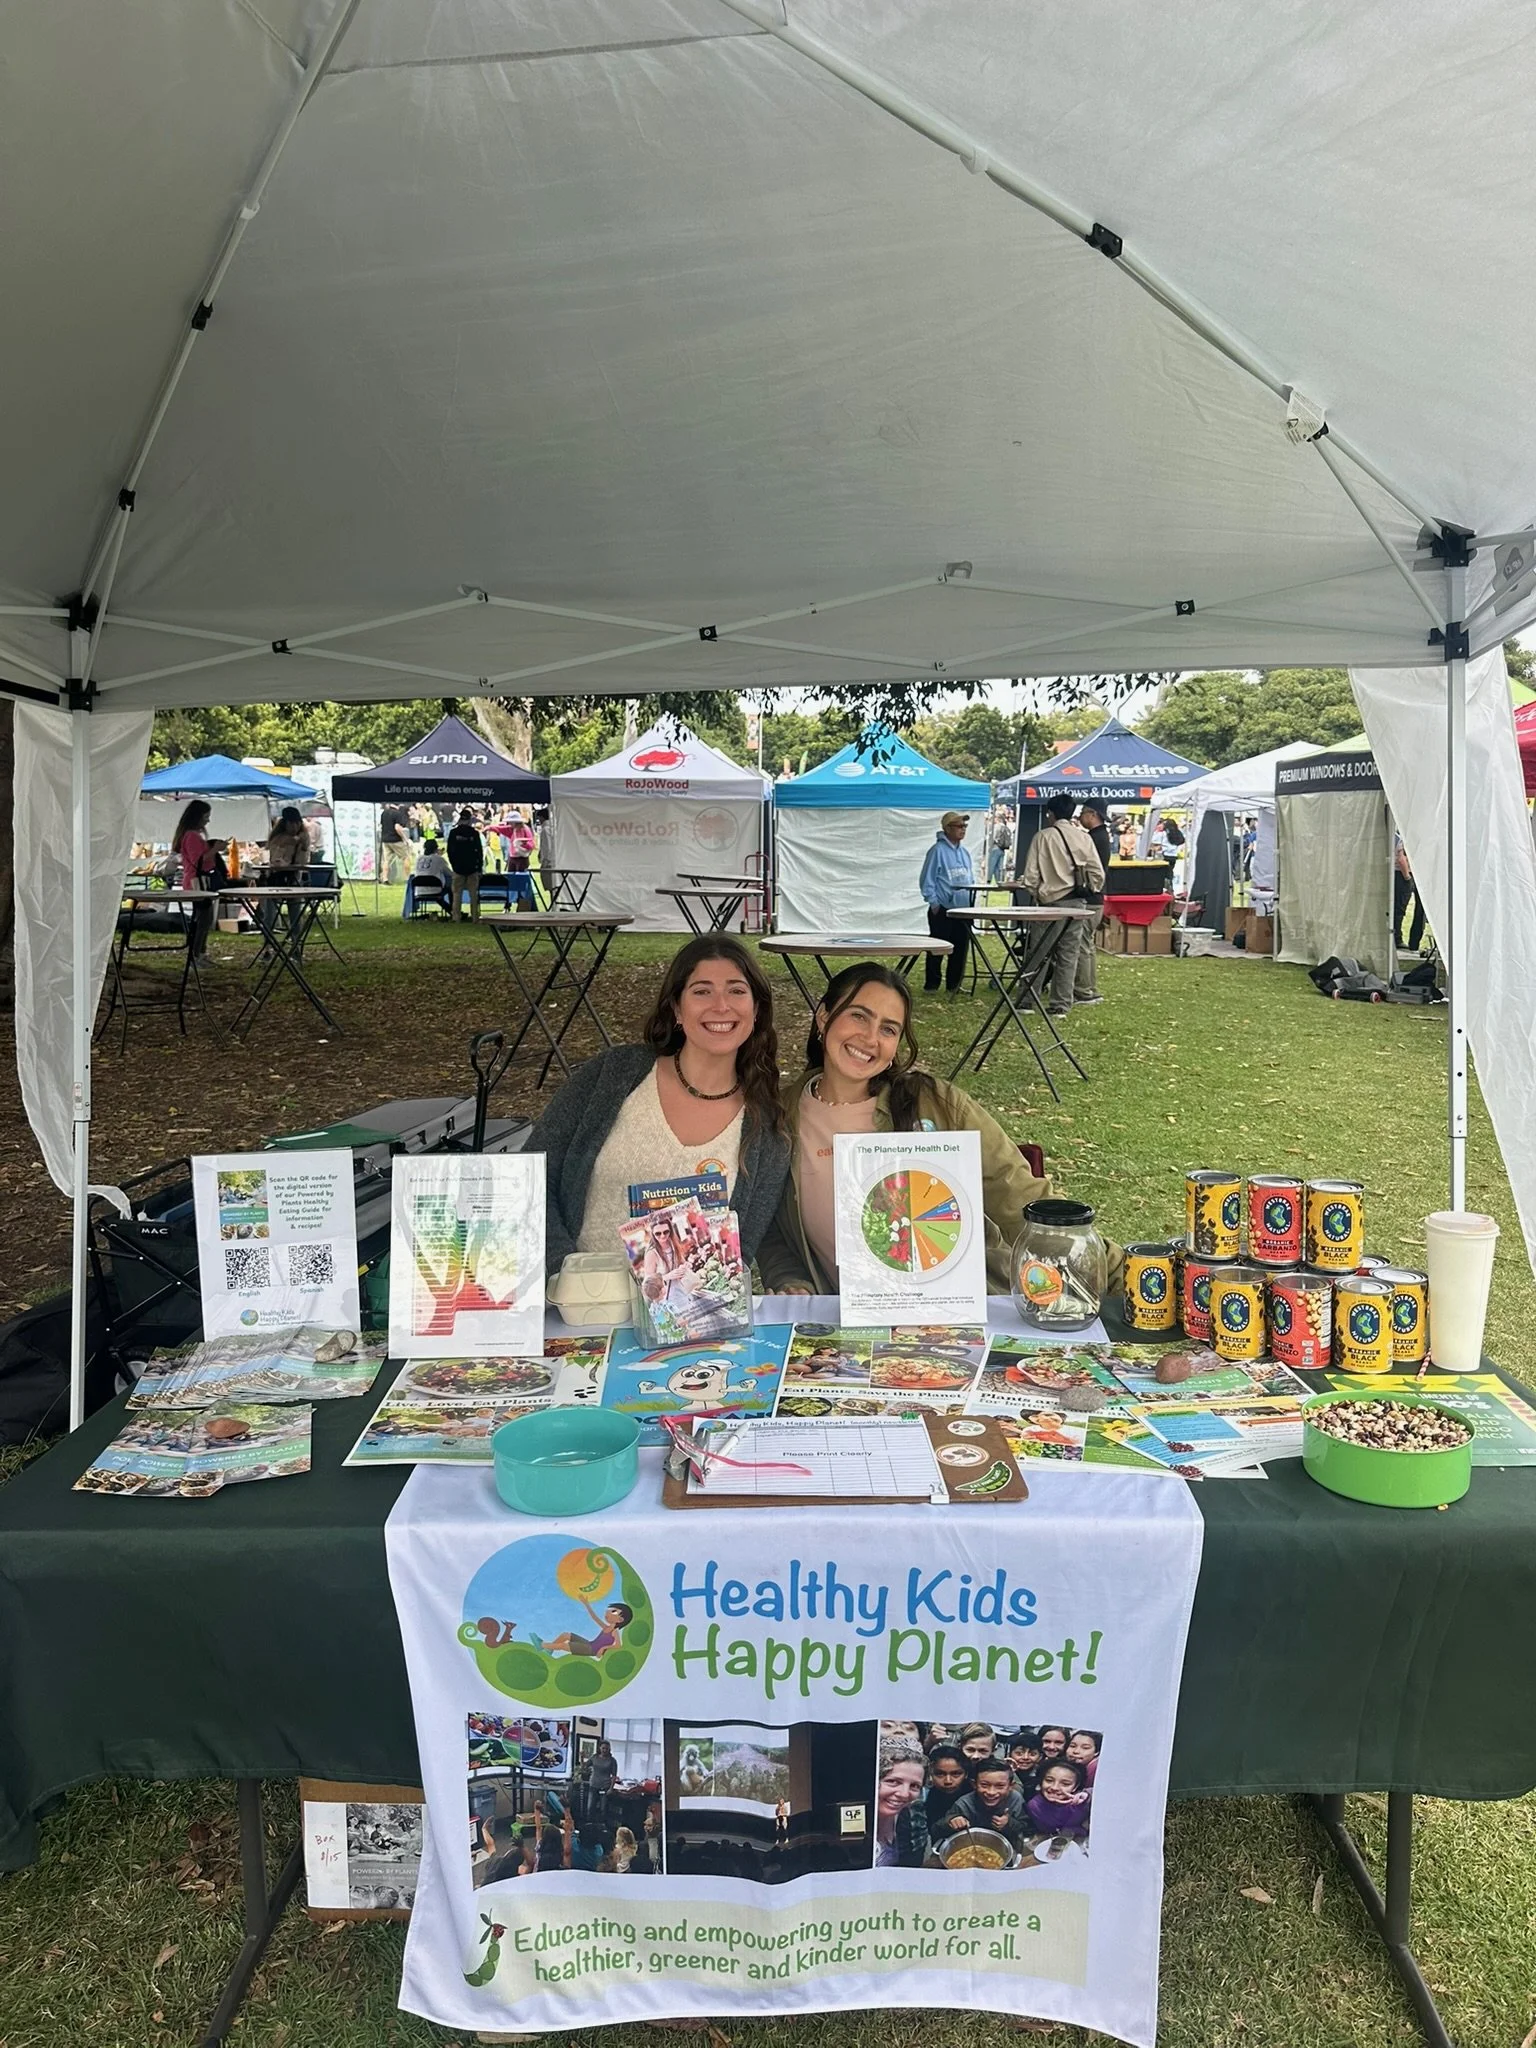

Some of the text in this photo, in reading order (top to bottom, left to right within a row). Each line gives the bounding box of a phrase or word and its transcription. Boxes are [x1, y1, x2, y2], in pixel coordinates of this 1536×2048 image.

[870, 764, 929, 777] AT&T
[1088, 764, 1190, 776] Lifetime
[1279, 761, 1380, 783] PREMIUM WINDOWS & DOOR
[384, 784, 495, 797] Life runs on clean energy.
[625, 778, 690, 790] RoJoWood
[1038, 786, 1136, 799] Windows & Doors
[857, 1144, 961, 1154] The Planetary Health Diet
[286, 1183, 308, 1191] digital
[642, 1186, 690, 1199] Nutrition
[698, 1182, 722, 1193] Kids
[1265, 1197, 1292, 1211] WESTBRAE
[1324, 1203, 1351, 1217] WESTBRAE
[141, 1227, 169, 1235] MAC
[1257, 1243, 1298, 1251] GARBANZO
[1323, 1251, 1349, 1259] BLACK
[1222, 1293, 1249, 1308] WESTBRAE
[1351, 1304, 1379, 1319] WESTBRAE
[1222, 1341, 1248, 1350] BLACK
[980, 1392, 1031, 1403] Plants
[1004, 1400, 1049, 1410] better
[785, 1420, 814, 1428] Happy
[191, 1443, 306, 1466] POWERED BY PLANTS
[840, 1450, 873, 1458] Clearly
[139, 1459, 183, 1469] POWERE
[671, 1560, 1038, 1637] Healthy Kids
[672, 1624, 1104, 1700] Happy Planet!
[514, 1908, 1042, 1954] Educating and empowering youth to create a
[533, 1933, 1023, 1983] healthier, greener and kinder world for all.
